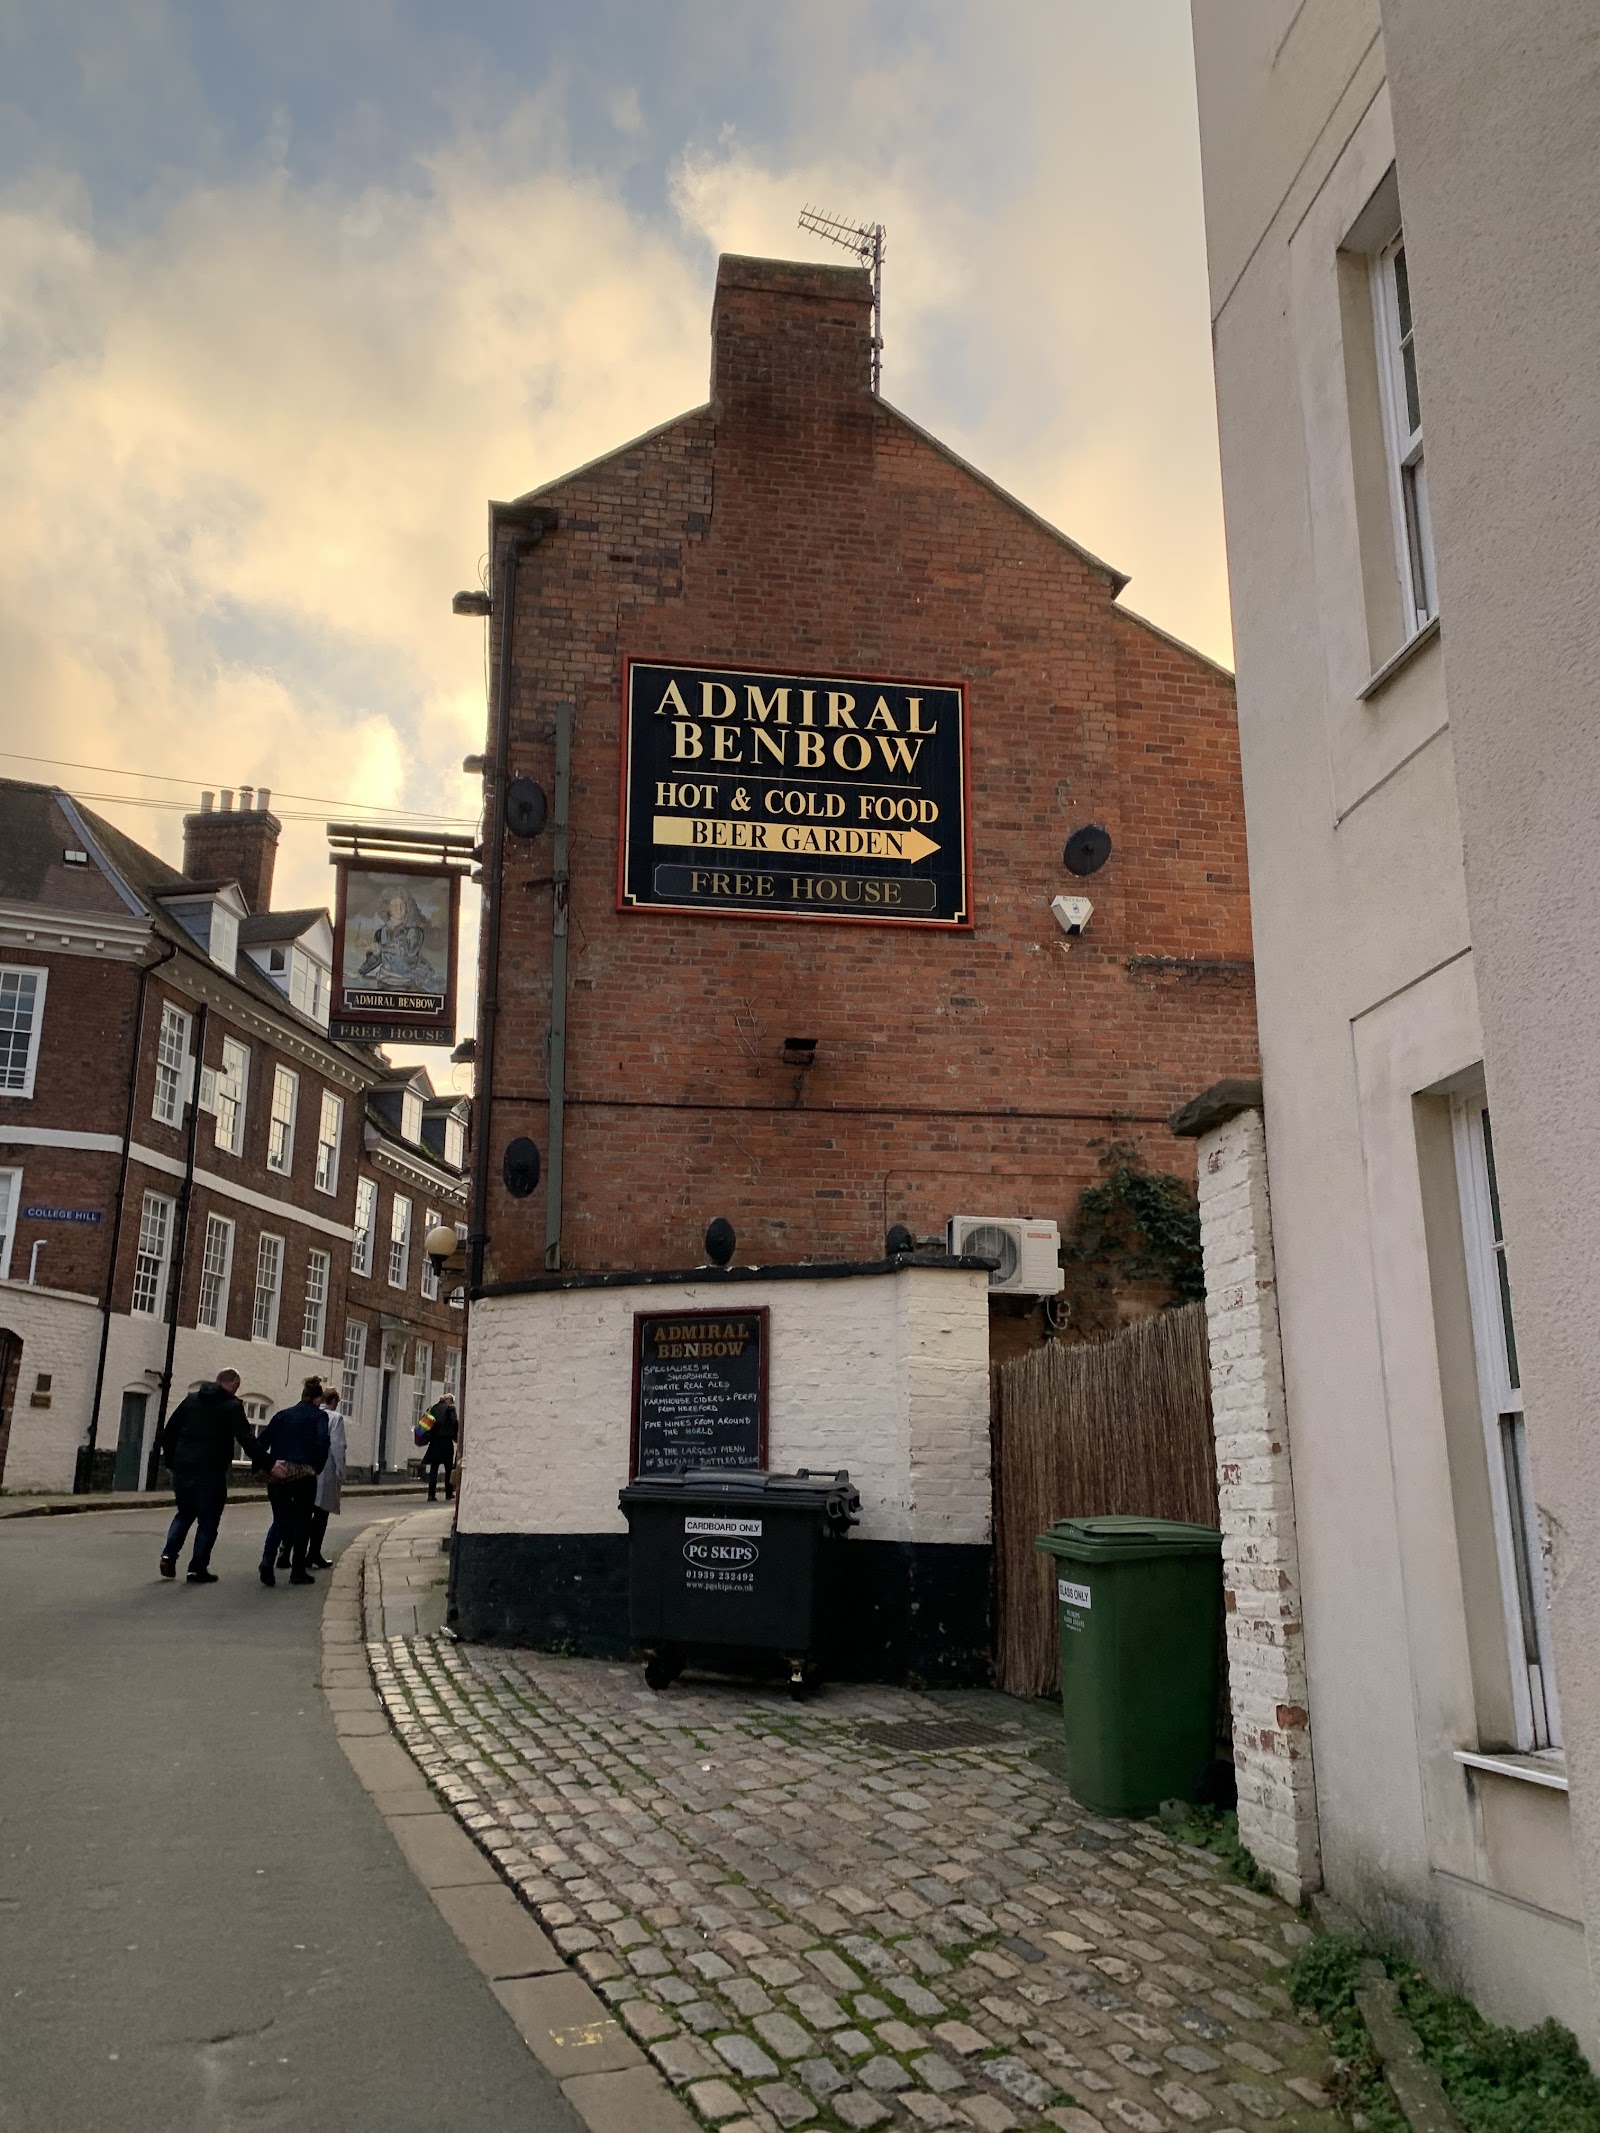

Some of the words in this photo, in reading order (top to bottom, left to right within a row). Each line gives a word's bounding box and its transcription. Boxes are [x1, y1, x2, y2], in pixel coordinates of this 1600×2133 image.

[654, 679, 938, 735] ADMIRAL
[670, 720, 924, 774] BENBOW
[655, 781, 718, 810] HOT
[730, 786, 751, 812] &
[764, 788, 845, 818] COLD
[858, 795, 939, 823] FOOD
[691, 820, 768, 849] BEER
[781, 827, 904, 856] GARDEN
[690, 870, 775, 898] FREE
[790, 876, 902, 904] HOUSE
[354, 994, 395, 1007] ADMIRAL
[398, 997, 436, 1009] BENBOW
[340, 1024, 382, 1038] FREE
[390, 1027, 445, 1041] HOUSE
[28, 1208, 73, 1219] COLLEGE
[75, 1211, 97, 1220] HILL
[654, 1323, 749, 1341] ADMIRAL
[657, 1341, 744, 1359] BENBOW
[683, 1381, 704, 1391] REAL
[643, 1398, 691, 1407] FARMHOUSE
[693, 1394, 725, 1404] CIDERS
[733, 1392, 758, 1402] PERRY
[657, 1405, 676, 1413] FROM
[678, 1404, 719, 1412] HEREFORD
[644, 1420, 662, 1429] FINE
[664, 1419, 692, 1428] WINES
[694, 1418, 715, 1427] FROM
[717, 1417, 752, 1425] AROUND
[663, 1429, 678, 1437] THE
[643, 1447, 661, 1456] AND
[663, 1447, 678, 1456] THE
[681, 1445, 717, 1455] LARGEST
[720, 1445, 746, 1454] MENU
[645, 1458, 654, 1467] OF
[687, 1521, 737, 1532] CARDBOARD
[739, 1524, 760, 1533] ONLY
[688, 1544, 708, 1558] PG
[710, 1546, 753, 1560] SKIPS
[686, 1570, 715, 1580] 01939
[1060, 1584, 1074, 1599] GLASS
[1074, 1589, 1089, 1602] ONLY
